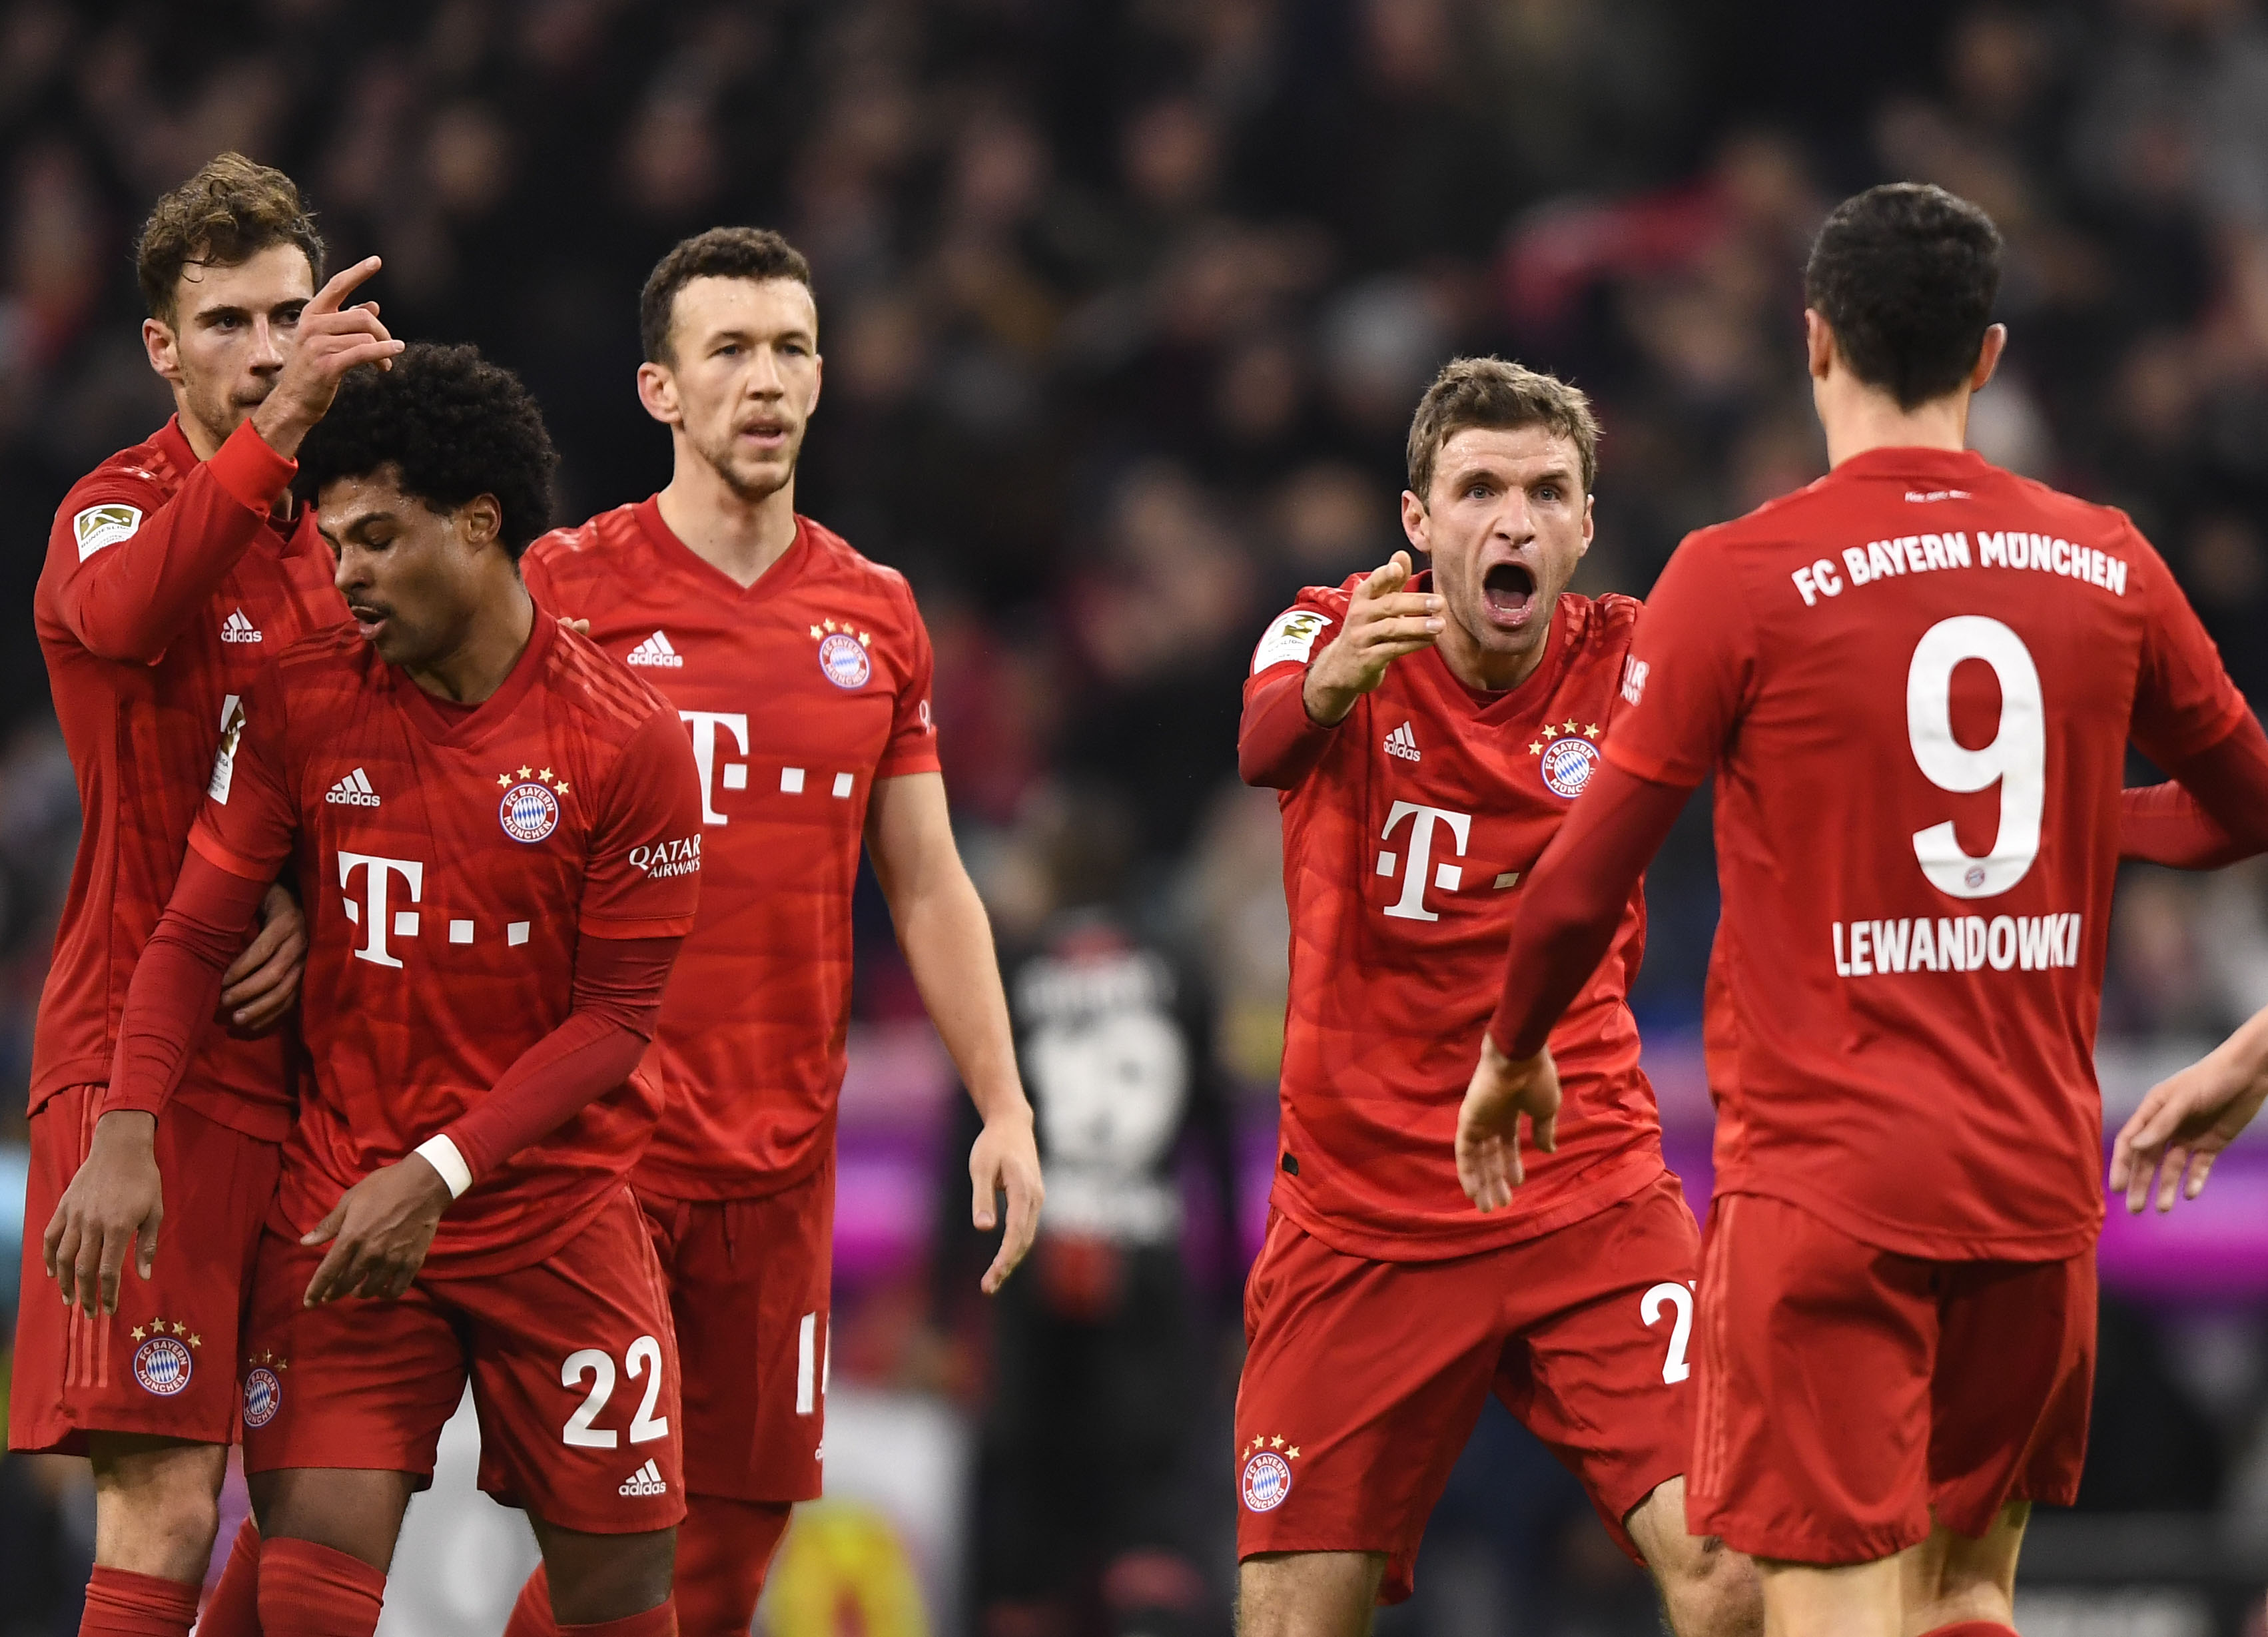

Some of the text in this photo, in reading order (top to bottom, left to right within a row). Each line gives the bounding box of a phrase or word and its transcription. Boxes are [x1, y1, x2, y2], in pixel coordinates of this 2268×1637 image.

[1792, 531, 2127, 606] FC BAYERN MÜNCHEN
[220, 628, 262, 643] adidas
[627, 651, 683, 669] adidas
[1383, 741, 1421, 763] adidas
[1545, 742, 1594, 770] FC BAYERN
[1906, 615, 2046, 899] 9
[678, 710, 749, 825] T
[325, 790, 381, 807] adidas
[506, 787, 555, 812] FC BAYERN
[629, 833, 701, 871] QATAR
[1381, 800, 1471, 922] T
[647, 856, 700, 878] AIRWAYS
[338, 850, 423, 968] T
[1832, 913, 2082, 977] LEWANDOWKI
[139, 1341, 188, 1365] FC BAYERN
[561, 1335, 669, 1449] 22
[1246, 1456, 1287, 1480] FC BAYERN
[618, 1480, 667, 1496] adidas
